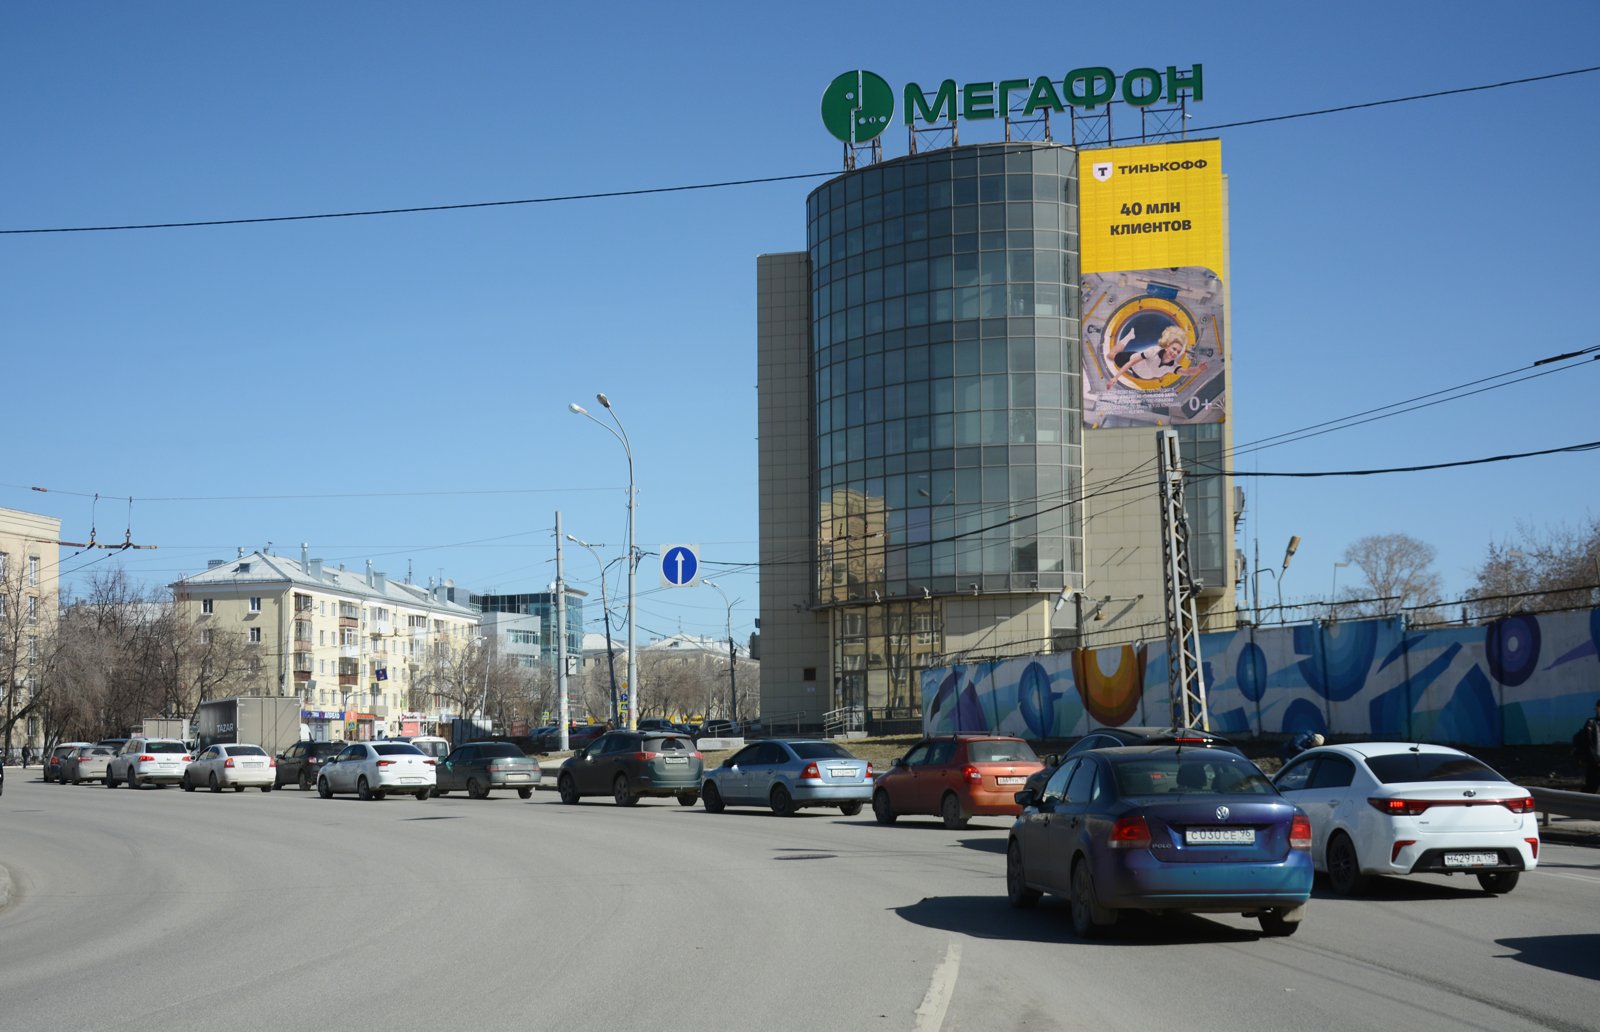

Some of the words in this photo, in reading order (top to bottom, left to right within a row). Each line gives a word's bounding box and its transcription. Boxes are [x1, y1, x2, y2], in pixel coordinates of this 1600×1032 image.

[904, 64, 1203, 126] МЕГАФОН
[1118, 159, 1208, 175] ТИНЬКОФФ
[1120, 202, 1142, 216] 40
[1146, 202, 1181, 215] млн
[1110, 220, 1192, 236] клиентов
[1189, 396, 1212, 411] 0+
[216, 723, 234, 733] TAZAR
